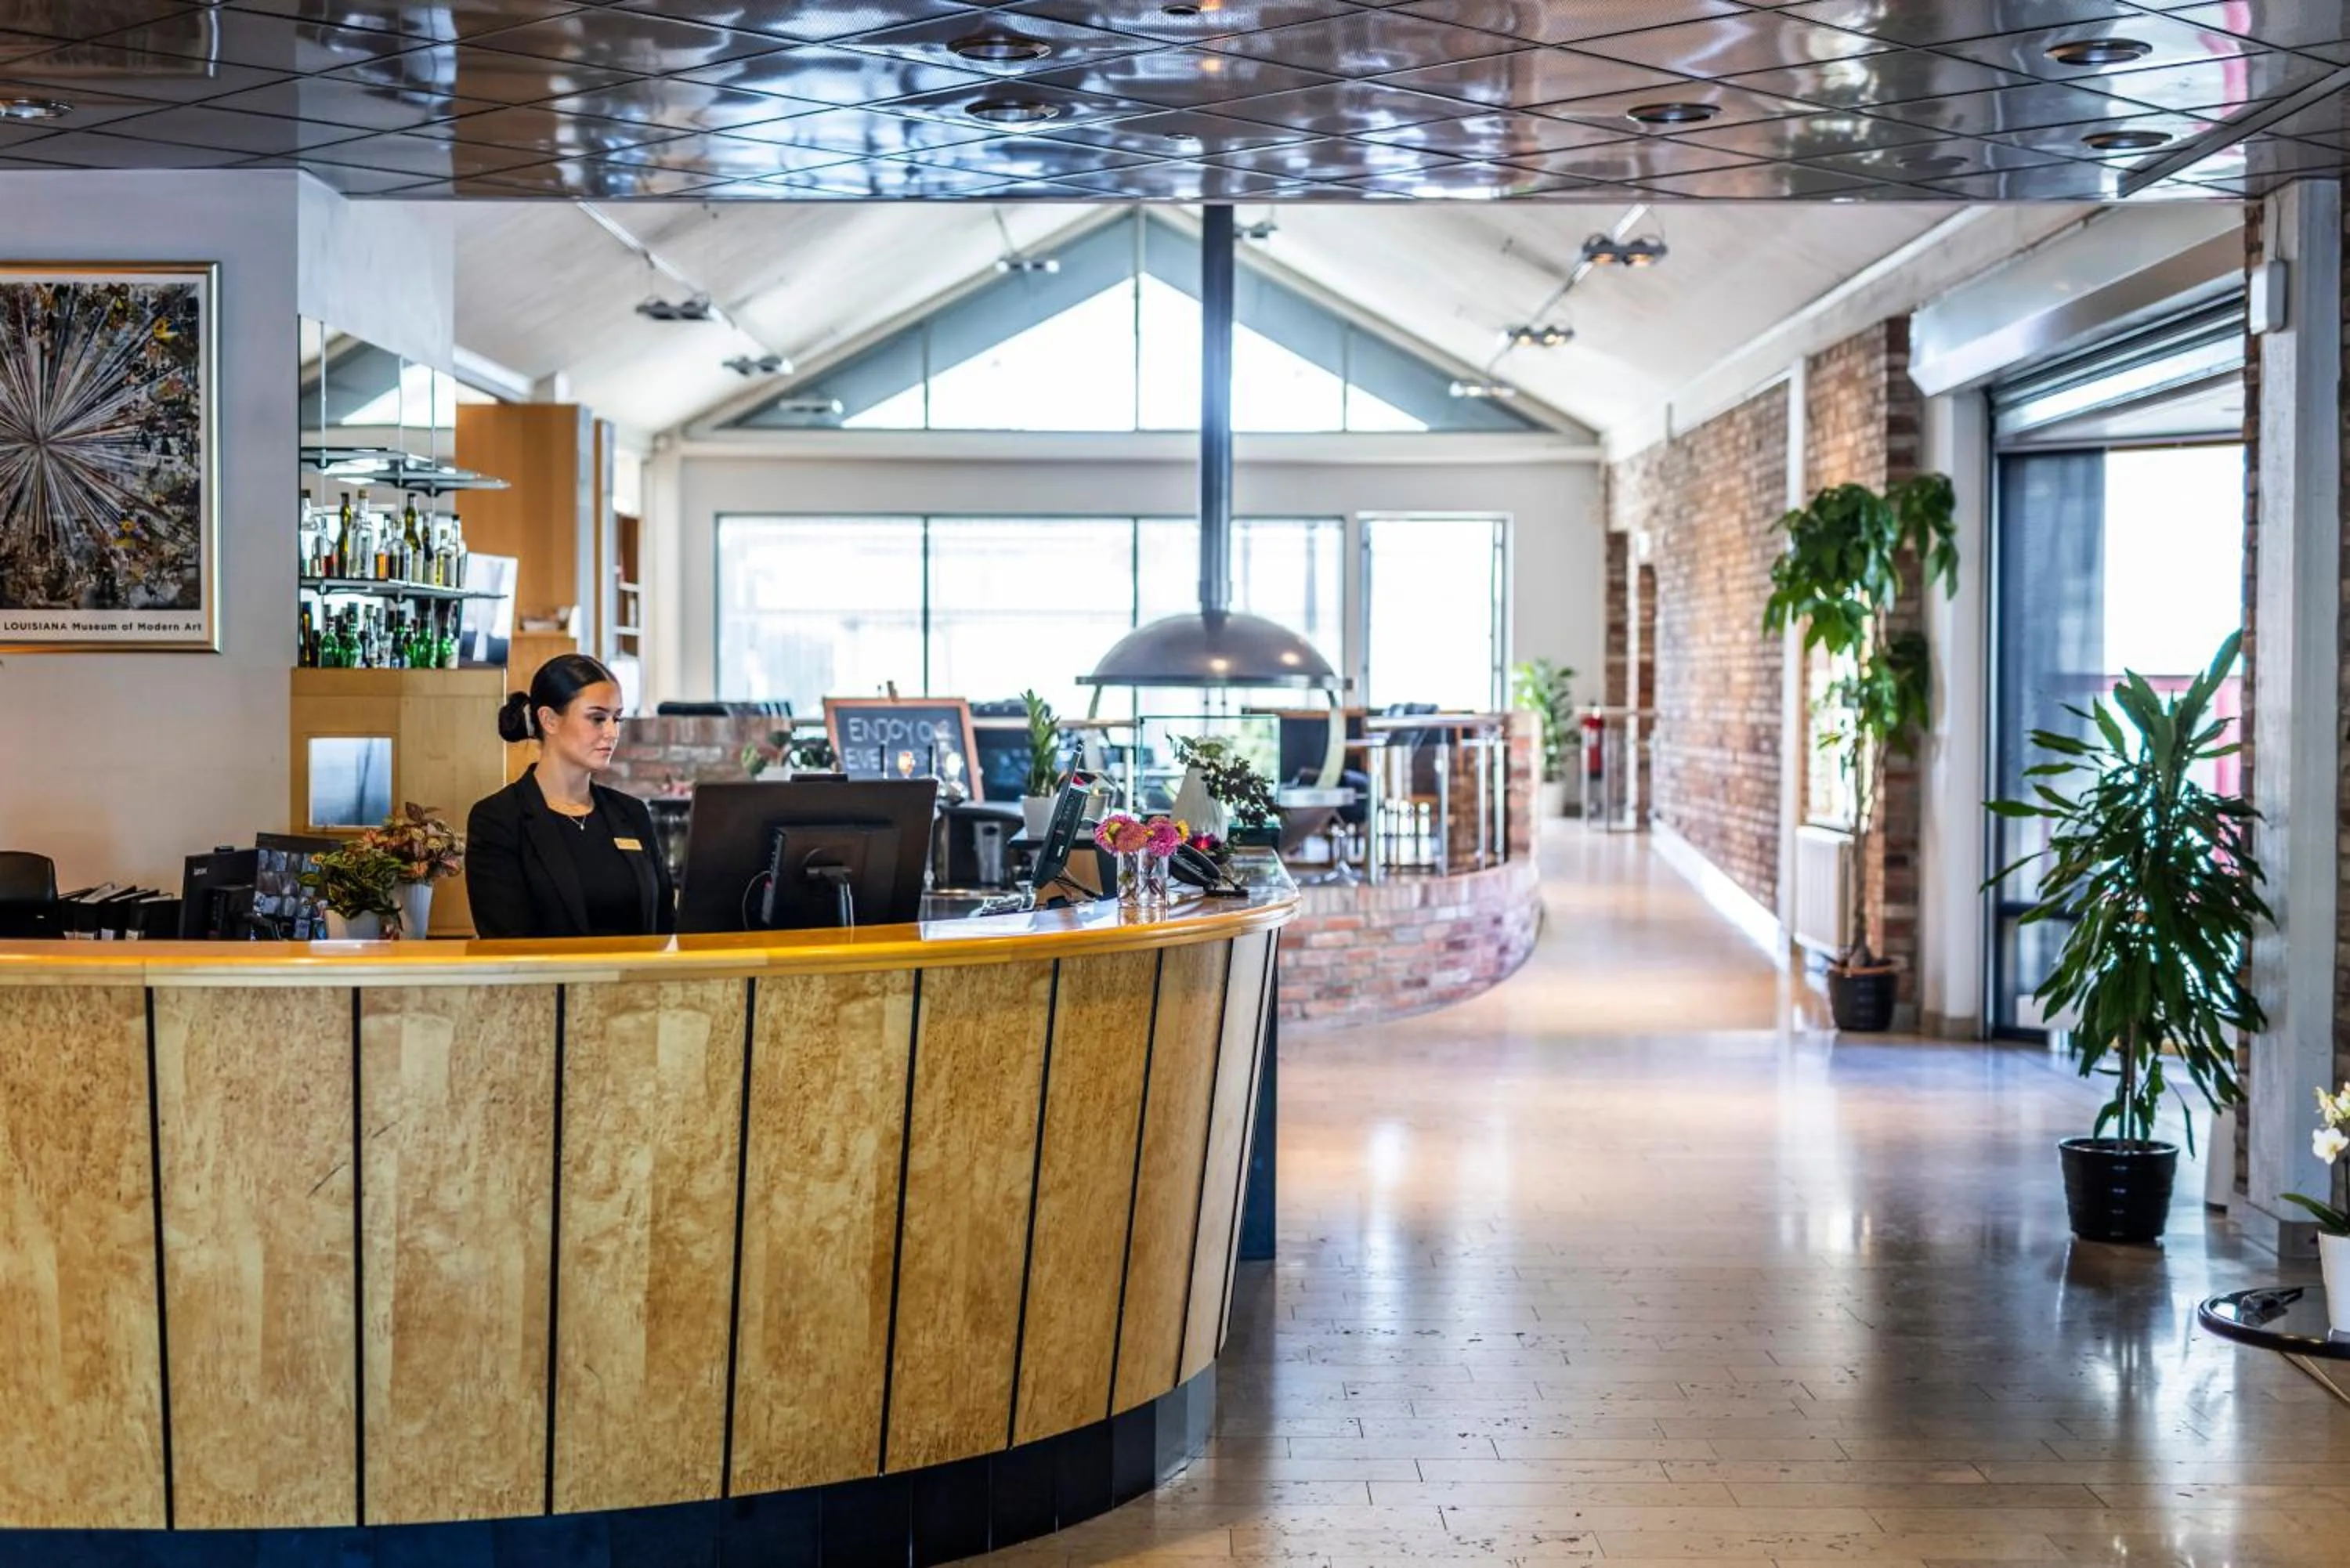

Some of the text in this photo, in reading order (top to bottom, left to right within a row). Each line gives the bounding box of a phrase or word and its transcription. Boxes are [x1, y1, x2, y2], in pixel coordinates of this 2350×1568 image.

[4, 621, 201, 630] LOUISIANA Museum of Modern Art
